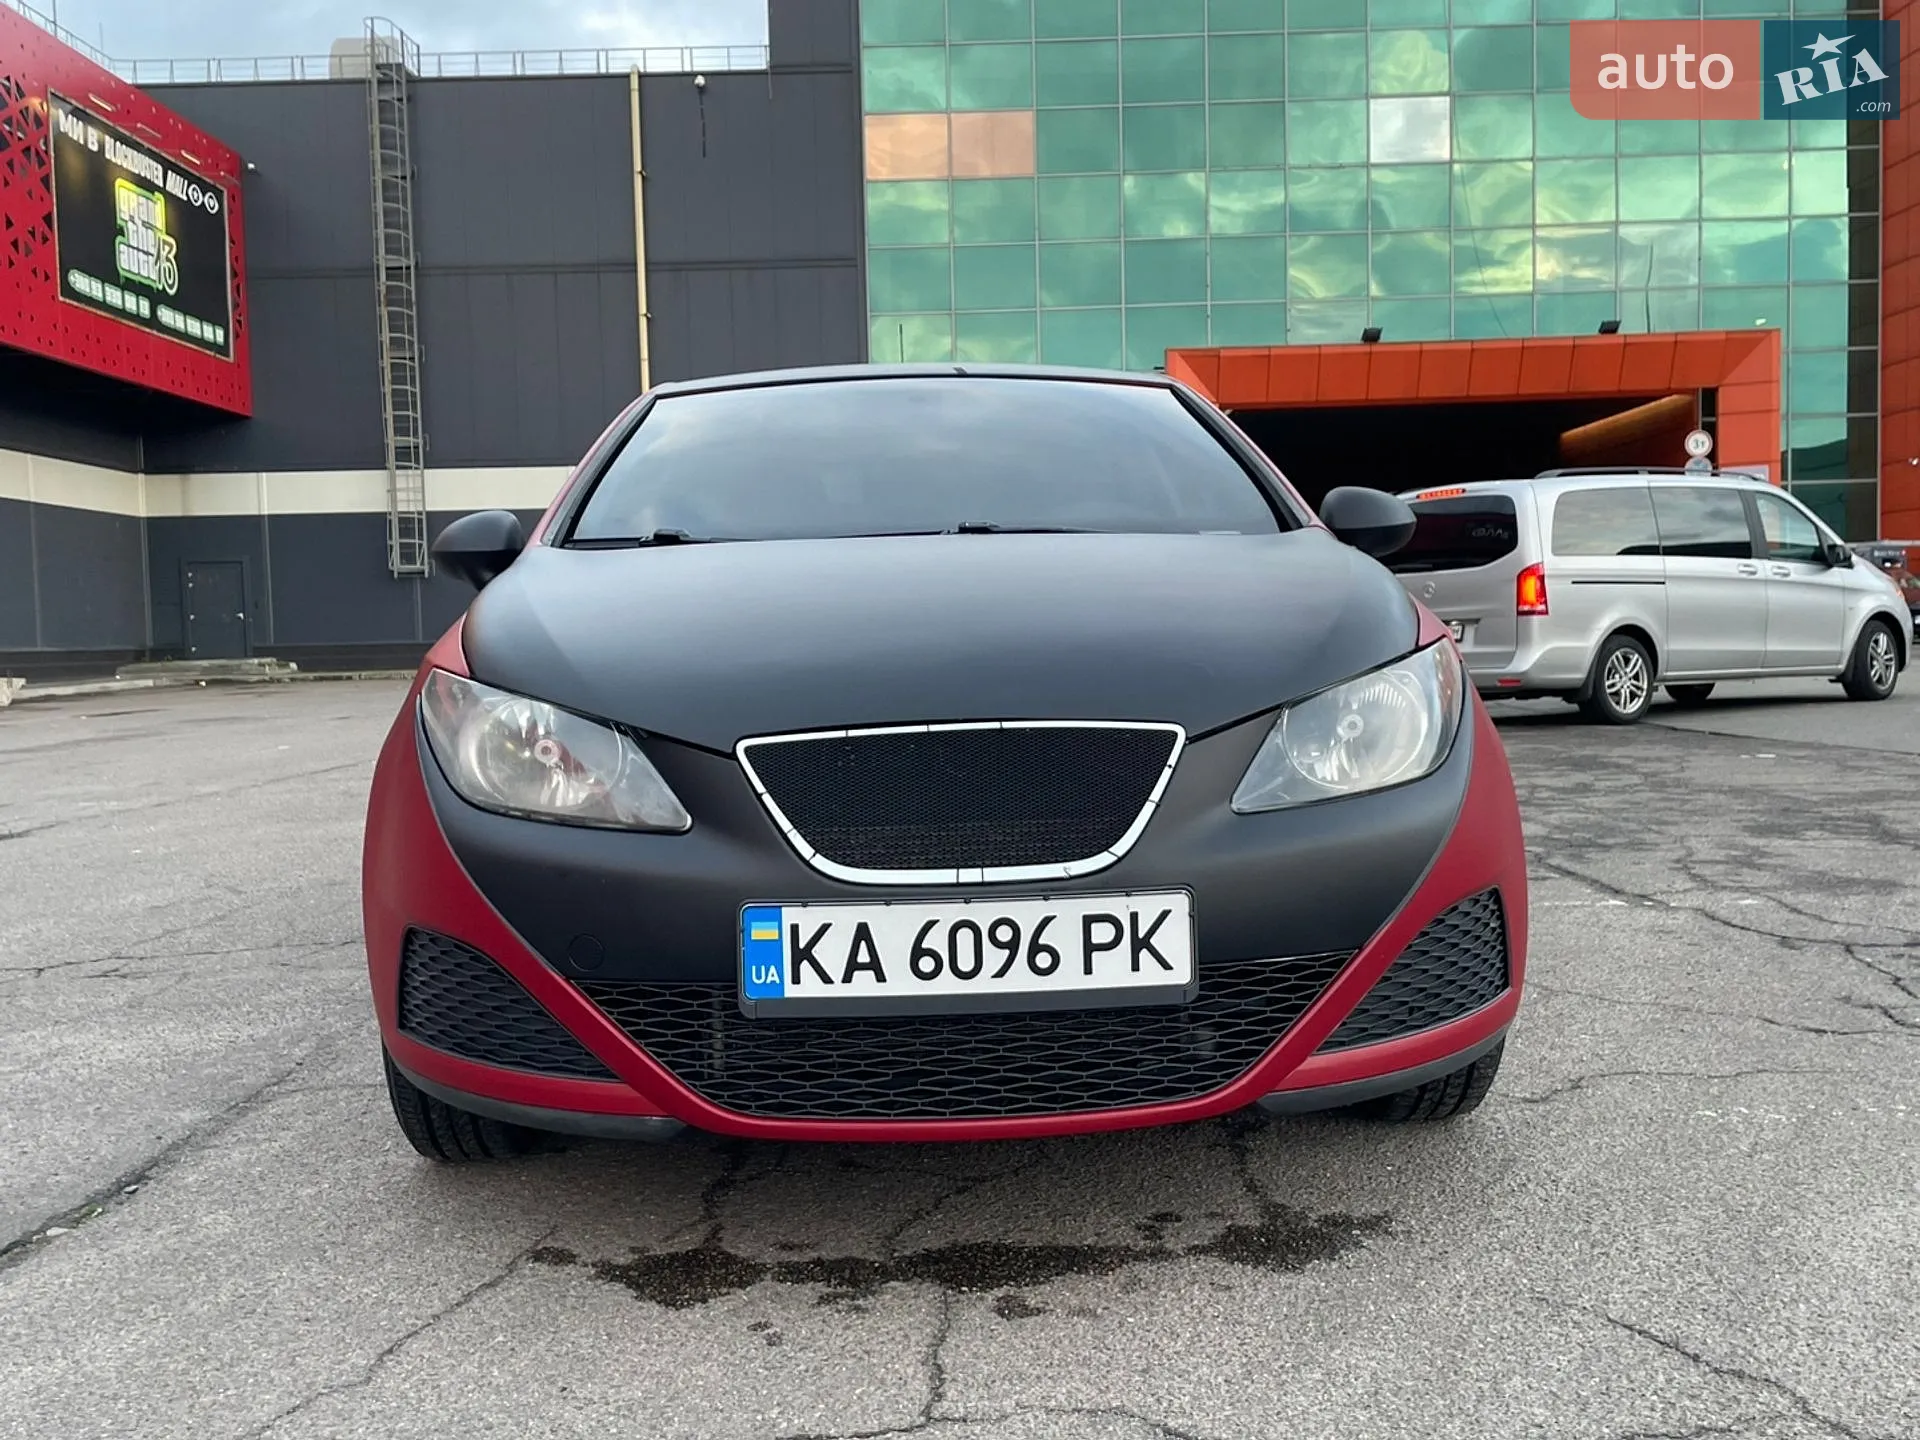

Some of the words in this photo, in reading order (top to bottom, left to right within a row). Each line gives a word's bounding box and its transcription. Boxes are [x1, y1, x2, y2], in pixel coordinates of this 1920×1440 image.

[789, 921, 887, 986] KA
[909, 914, 1062, 982] 6096
[1081, 908, 1174, 976] PK
[751, 964, 780, 985] UA
